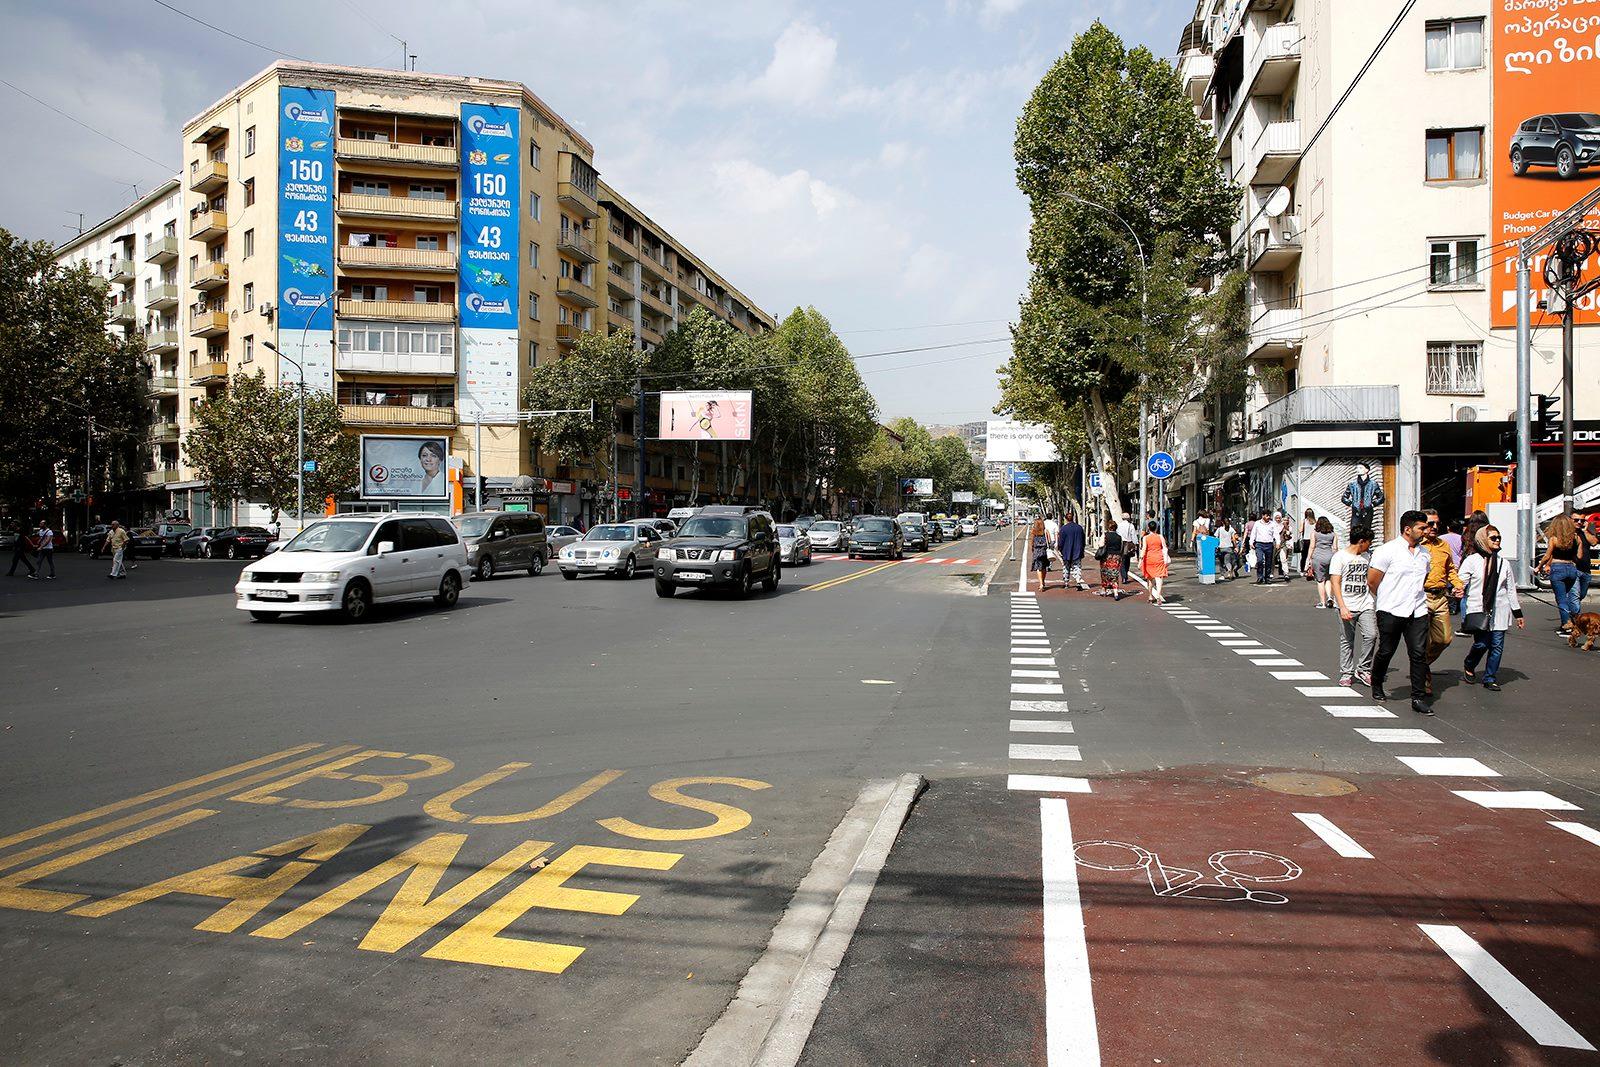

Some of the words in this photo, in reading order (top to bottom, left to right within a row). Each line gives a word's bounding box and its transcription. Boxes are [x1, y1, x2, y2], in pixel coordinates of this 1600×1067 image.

[289, 159, 323, 181] 150
[473, 173, 507, 196] 150
[293, 210, 318, 232] 43
[1503, 211, 1534, 220] Budget
[477, 225, 501, 248] 43
[1503, 224, 1536, 233] Phone
[735, 402, 746, 438] SKIN
[1018, 433, 1033, 441] only
[375, 467, 384, 479] 2
[228, 749, 773, 841] BUS
[0, 808, 684, 974] LANE
